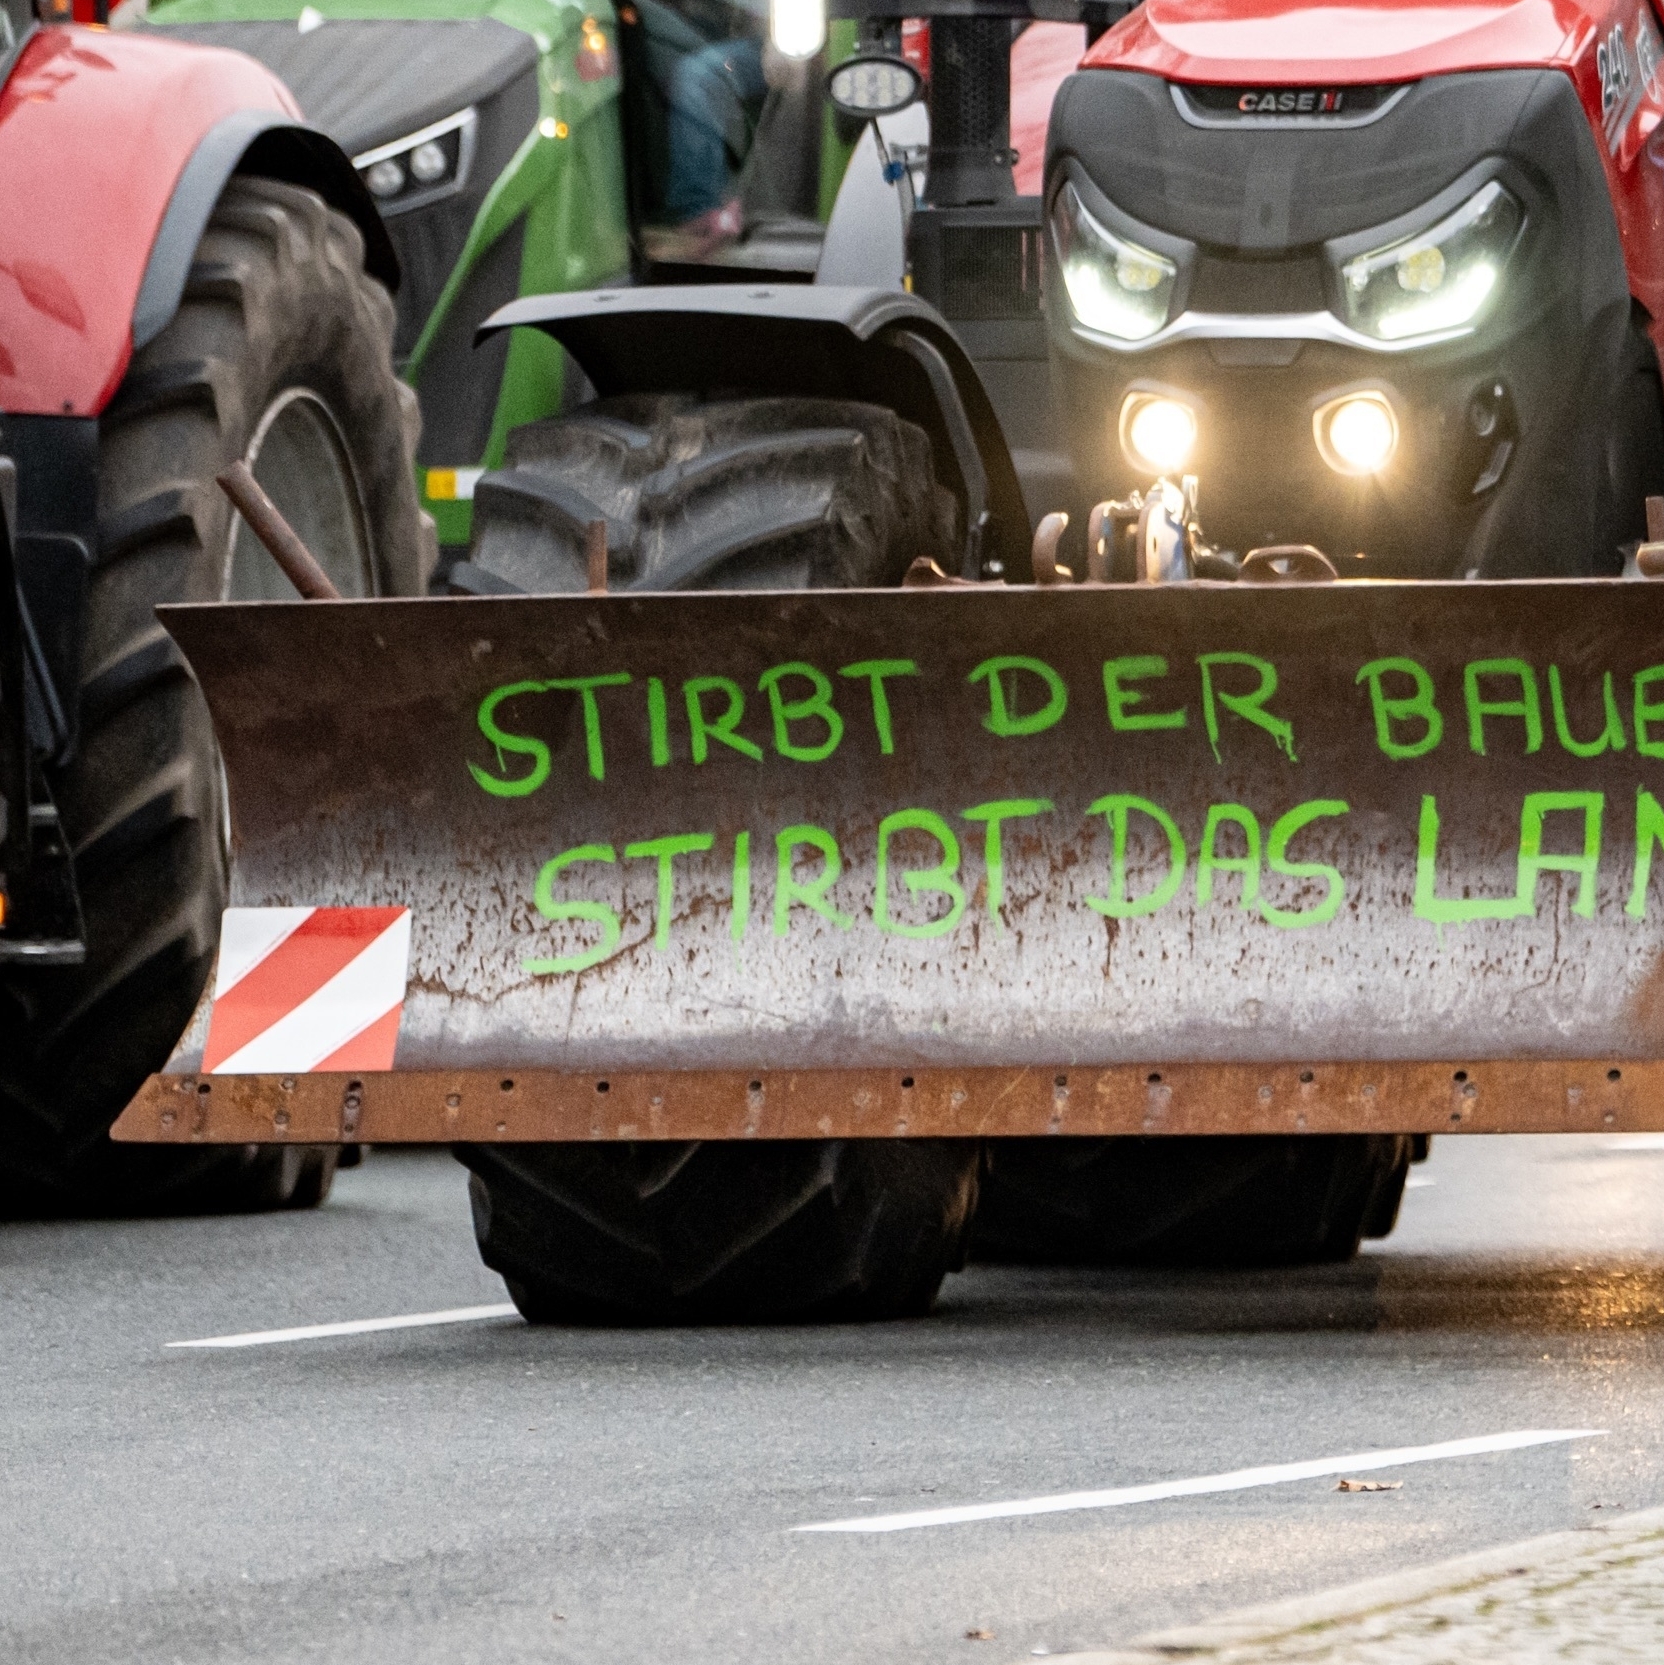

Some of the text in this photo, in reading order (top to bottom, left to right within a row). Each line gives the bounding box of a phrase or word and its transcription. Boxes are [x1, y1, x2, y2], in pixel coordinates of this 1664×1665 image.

[1238, 92, 1316, 112] CASE
[467, 659, 920, 797] STIRBT
[969, 652, 1298, 764] DER
[521, 799, 1055, 974] STIRBT
[1085, 792, 1351, 929] DAS
